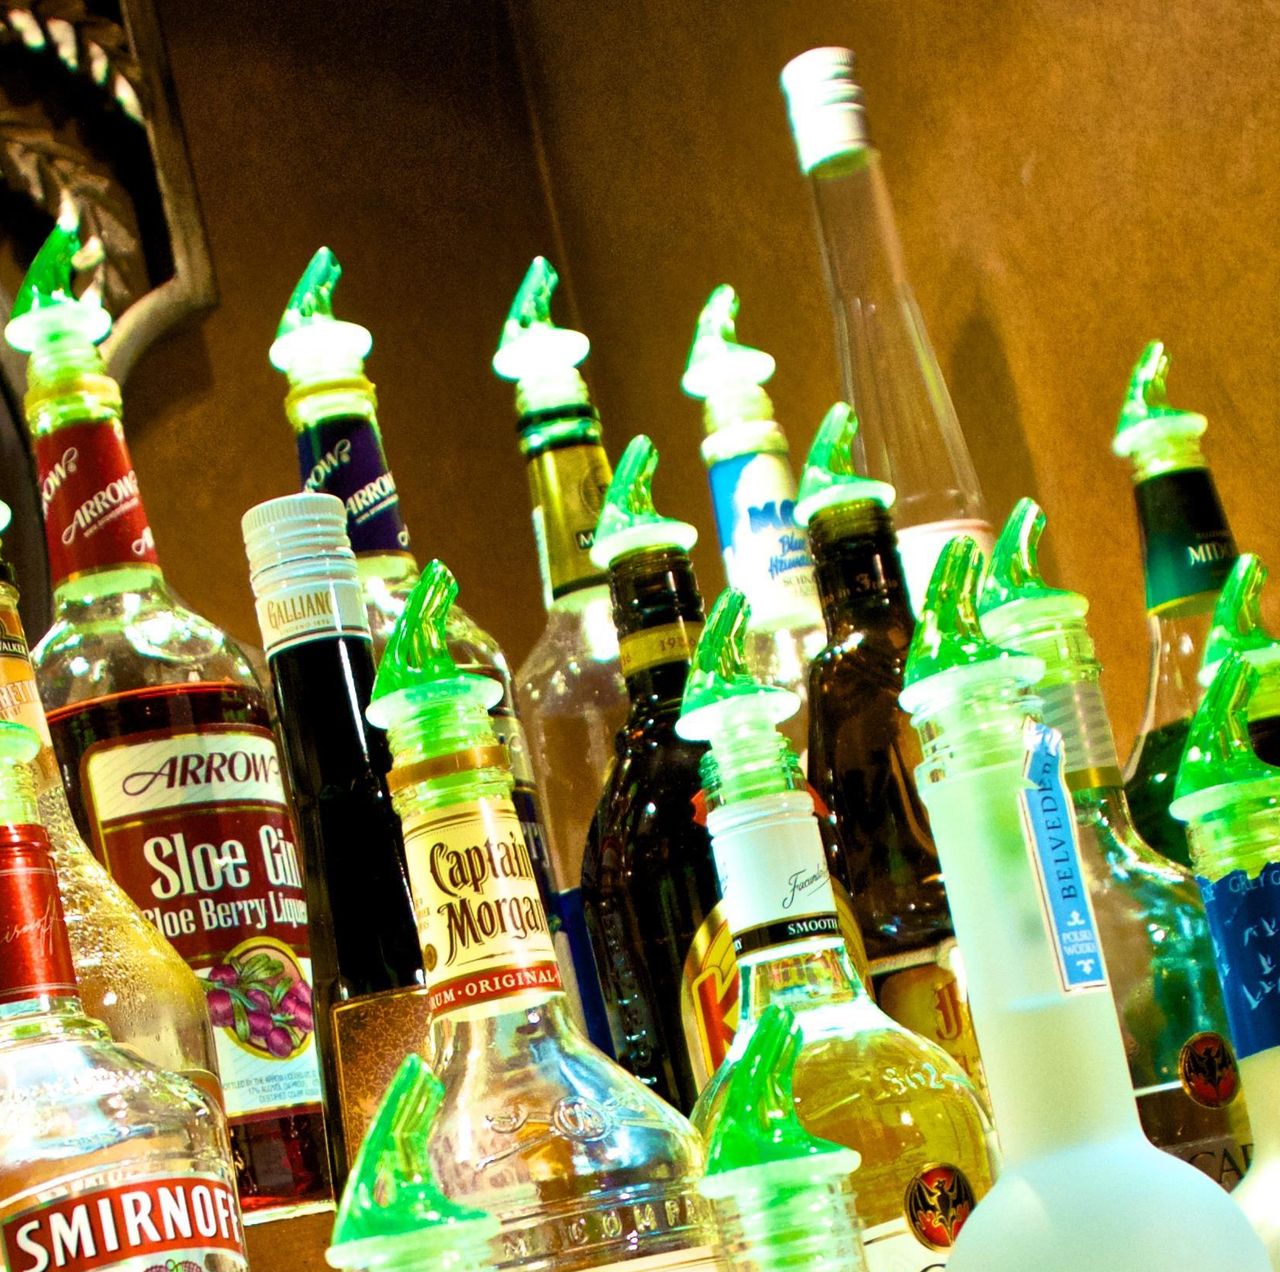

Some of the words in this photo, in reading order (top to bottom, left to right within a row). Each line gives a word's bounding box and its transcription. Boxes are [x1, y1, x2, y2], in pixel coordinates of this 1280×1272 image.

[123, 750, 282, 797] ARROW
[144, 823, 250, 901] Sloe
[258, 821, 303, 885] Gin
[429, 832, 534, 903] Captain
[203, 896, 269, 936] Berry
[436, 893, 549, 968] Morgan
[787, 917, 838, 936] SMOOTH
[465, 970, 555, 998] ORIGINAL
